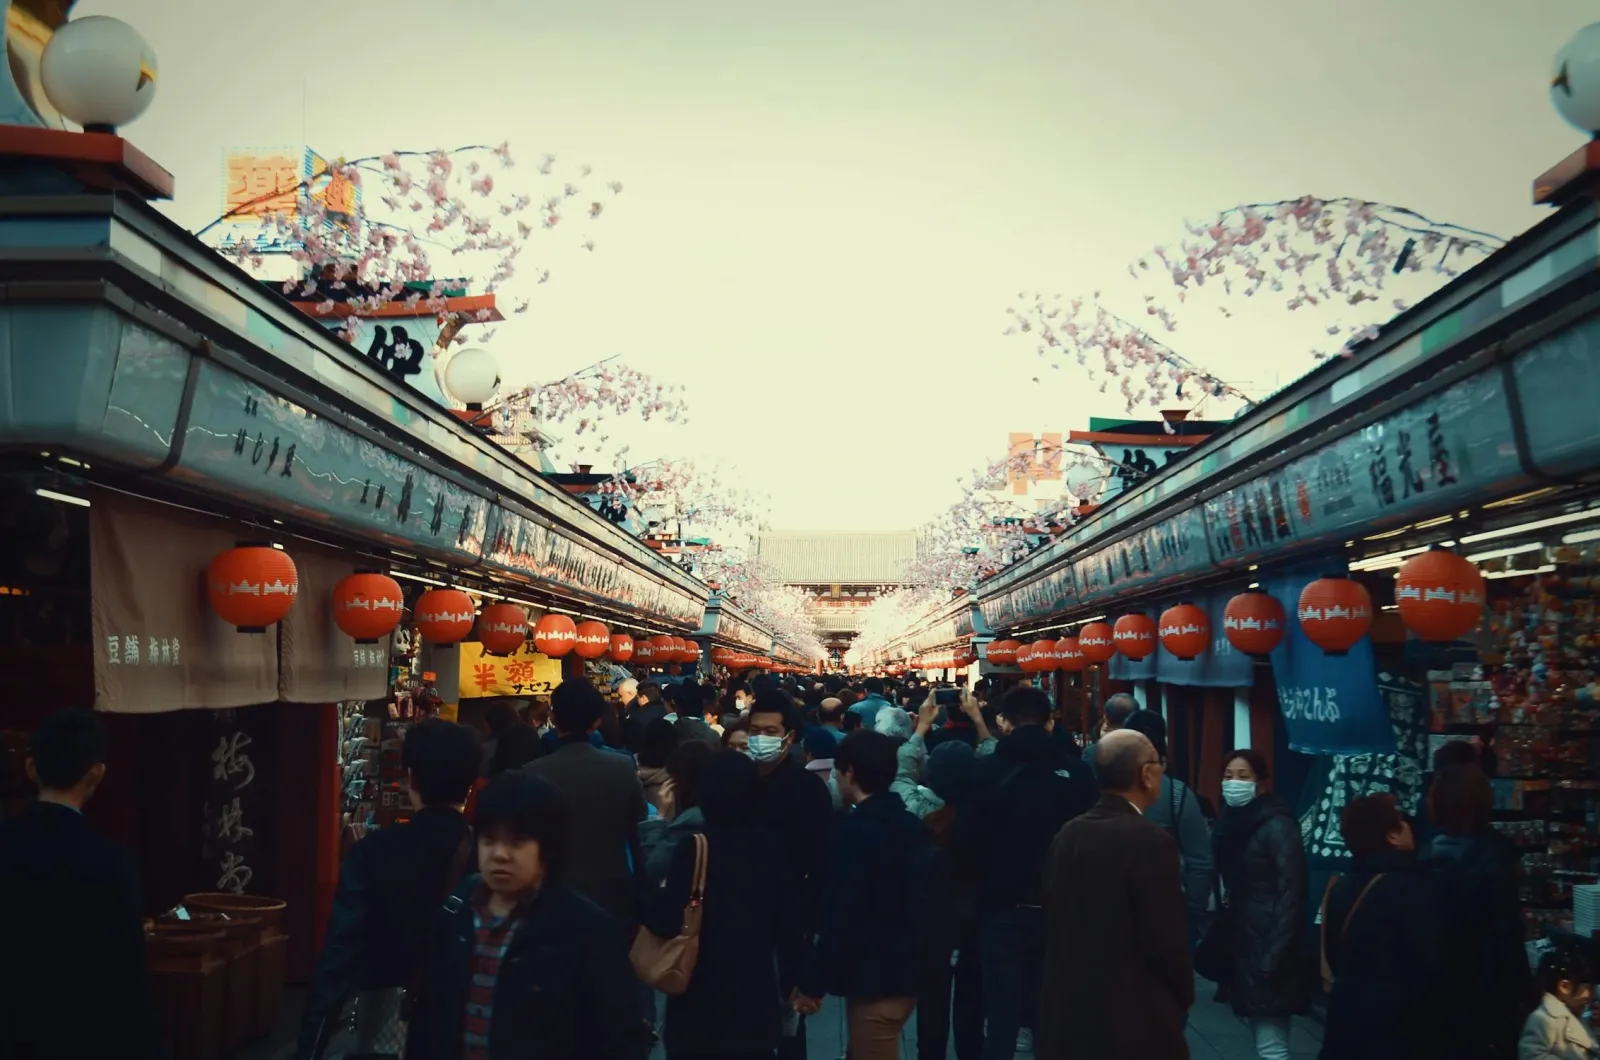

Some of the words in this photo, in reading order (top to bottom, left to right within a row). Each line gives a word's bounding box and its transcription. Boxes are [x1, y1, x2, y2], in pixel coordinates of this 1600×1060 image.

[473, 659, 537, 693] 半額
[512, 681, 556, 694] サービス
